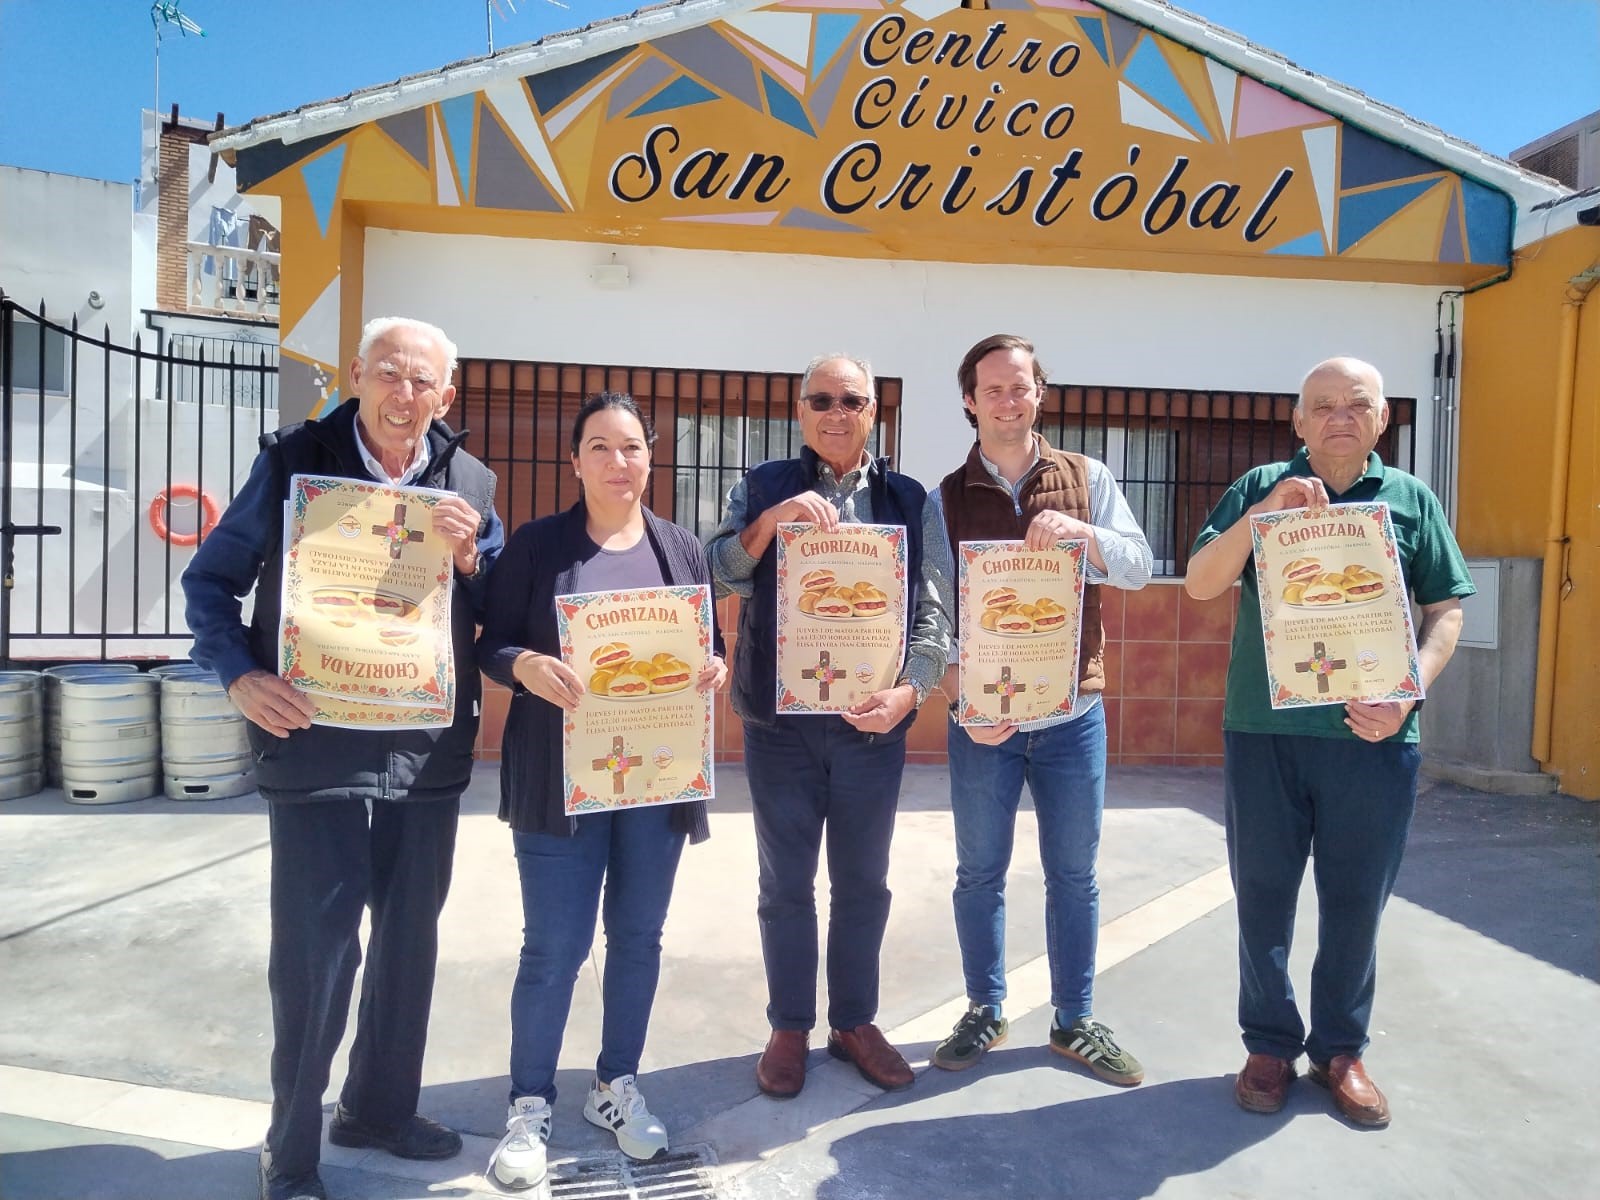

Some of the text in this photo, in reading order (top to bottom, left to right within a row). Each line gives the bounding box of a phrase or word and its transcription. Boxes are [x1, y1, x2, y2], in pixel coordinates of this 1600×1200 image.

[860, 15, 1082, 77] Centro
[853, 77, 1075, 140] Cívico
[608, 126, 1294, 242] San Cristóbal
[1279, 524, 1365, 547] CHORIZADA
[801, 540, 878, 558] CHORIZADA
[982, 557, 1060, 575] CHORIZADA
[586, 607, 679, 630] CHORIZADA
[1320, 623, 1346, 631] HORAS
[1356, 612, 1382, 620] PARTIR
[1307, 632, 1333, 640] ELVIRA
[321, 654, 419, 679] CHORIZADA
